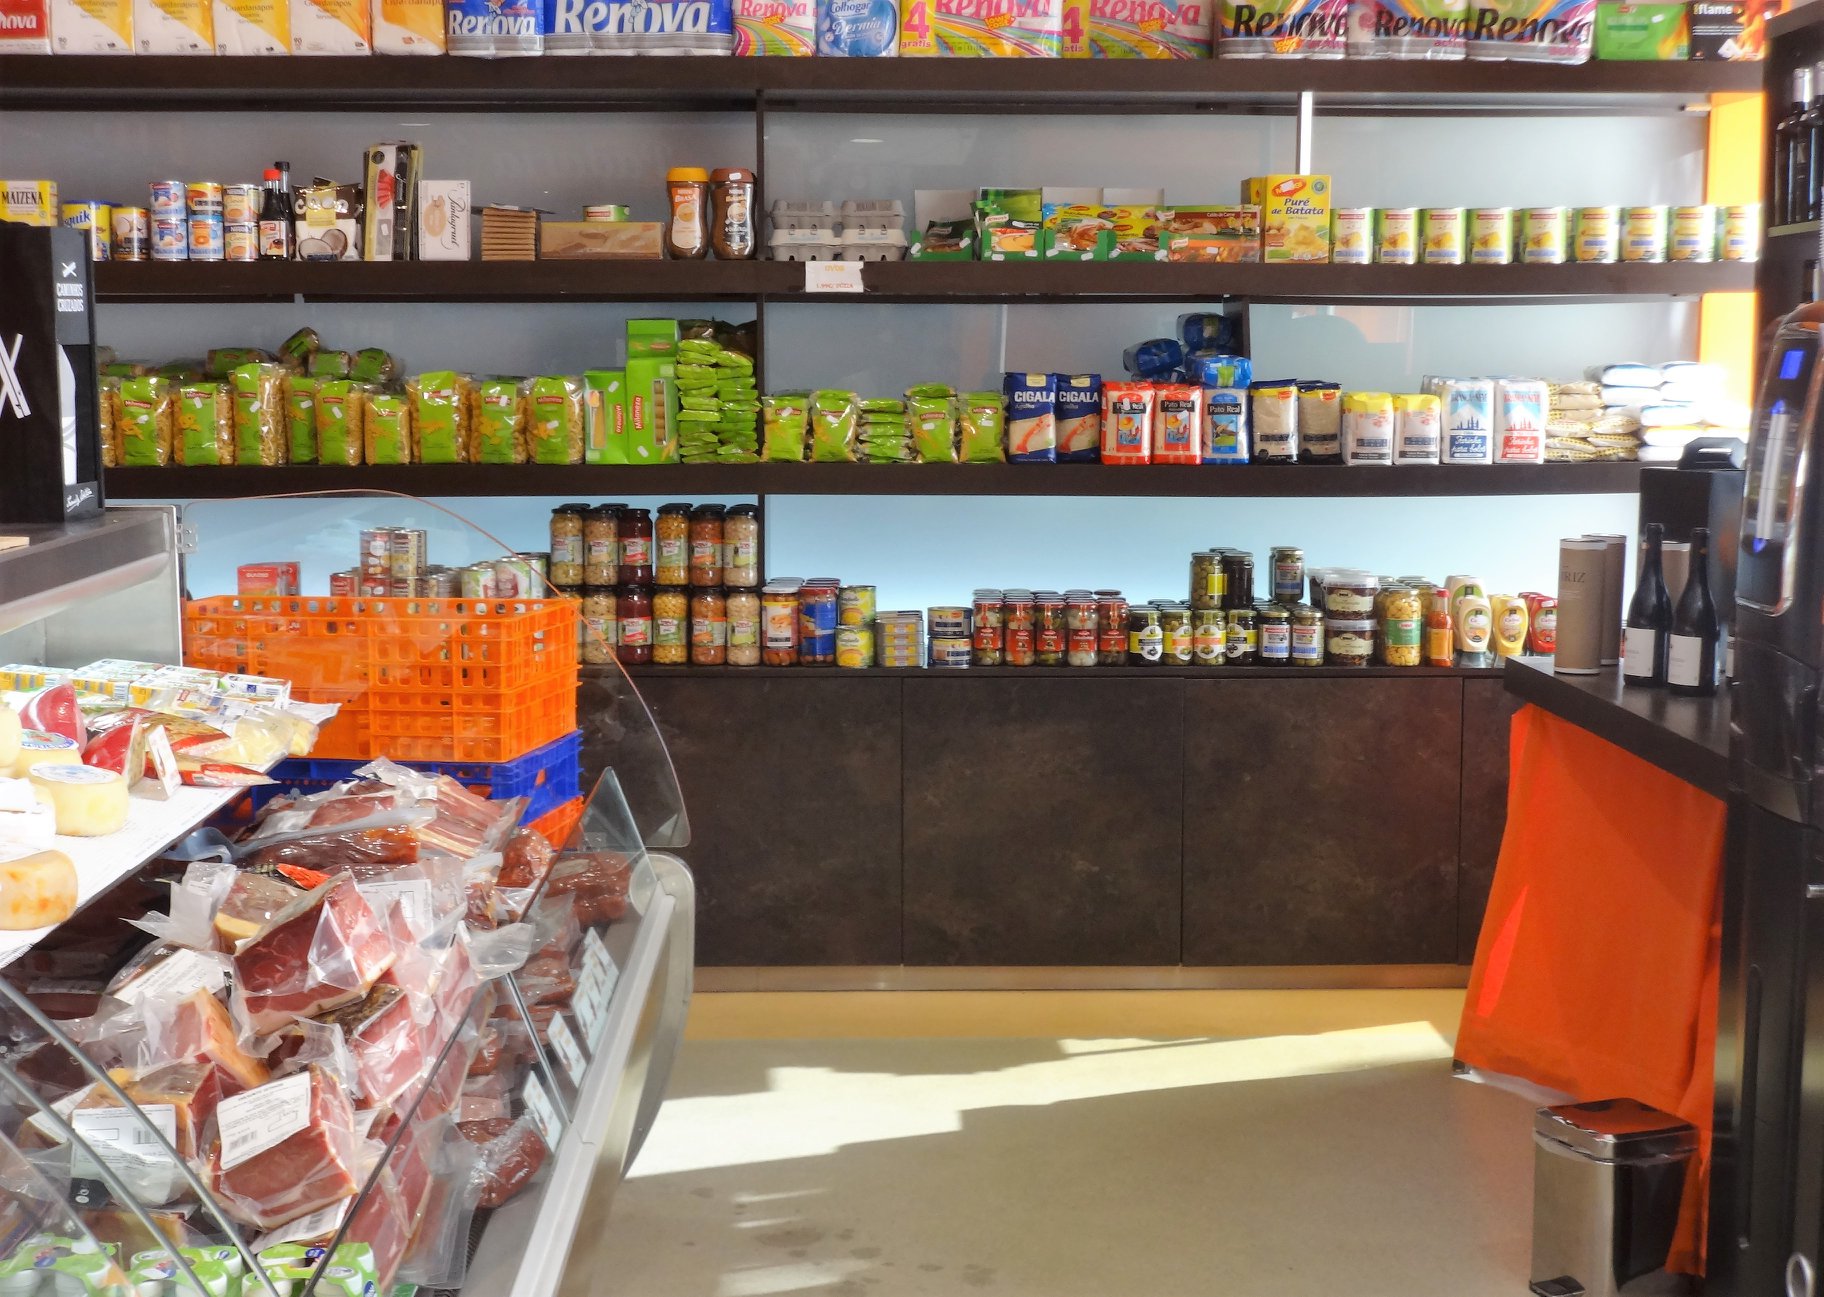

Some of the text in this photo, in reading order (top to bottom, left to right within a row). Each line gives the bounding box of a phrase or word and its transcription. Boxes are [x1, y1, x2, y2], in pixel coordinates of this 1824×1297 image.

[741, 0, 807, 18] Renova
[830, 0, 872, 13] Colhogar
[935, 0, 1050, 18] Renova
[1090, 0, 1201, 25] Renova
[449, 9, 536, 35] Renova
[555, 0, 711, 34] Renova
[904, 2, 929, 39] 4
[1063, 7, 1084, 43] 4
[1474, 8, 1592, 44] Renova
[2, 191, 44, 205] MAIZENA
[1284, 197, 1310, 206] Puré
[1285, 206, 1324, 215] Batata
[1014, 391, 1056, 403] CIGALA
[1059, 391, 1099, 403] CIGALA
[633, 397, 645, 429] Milaneza
[1209, 404, 1241, 414] Pato Real
